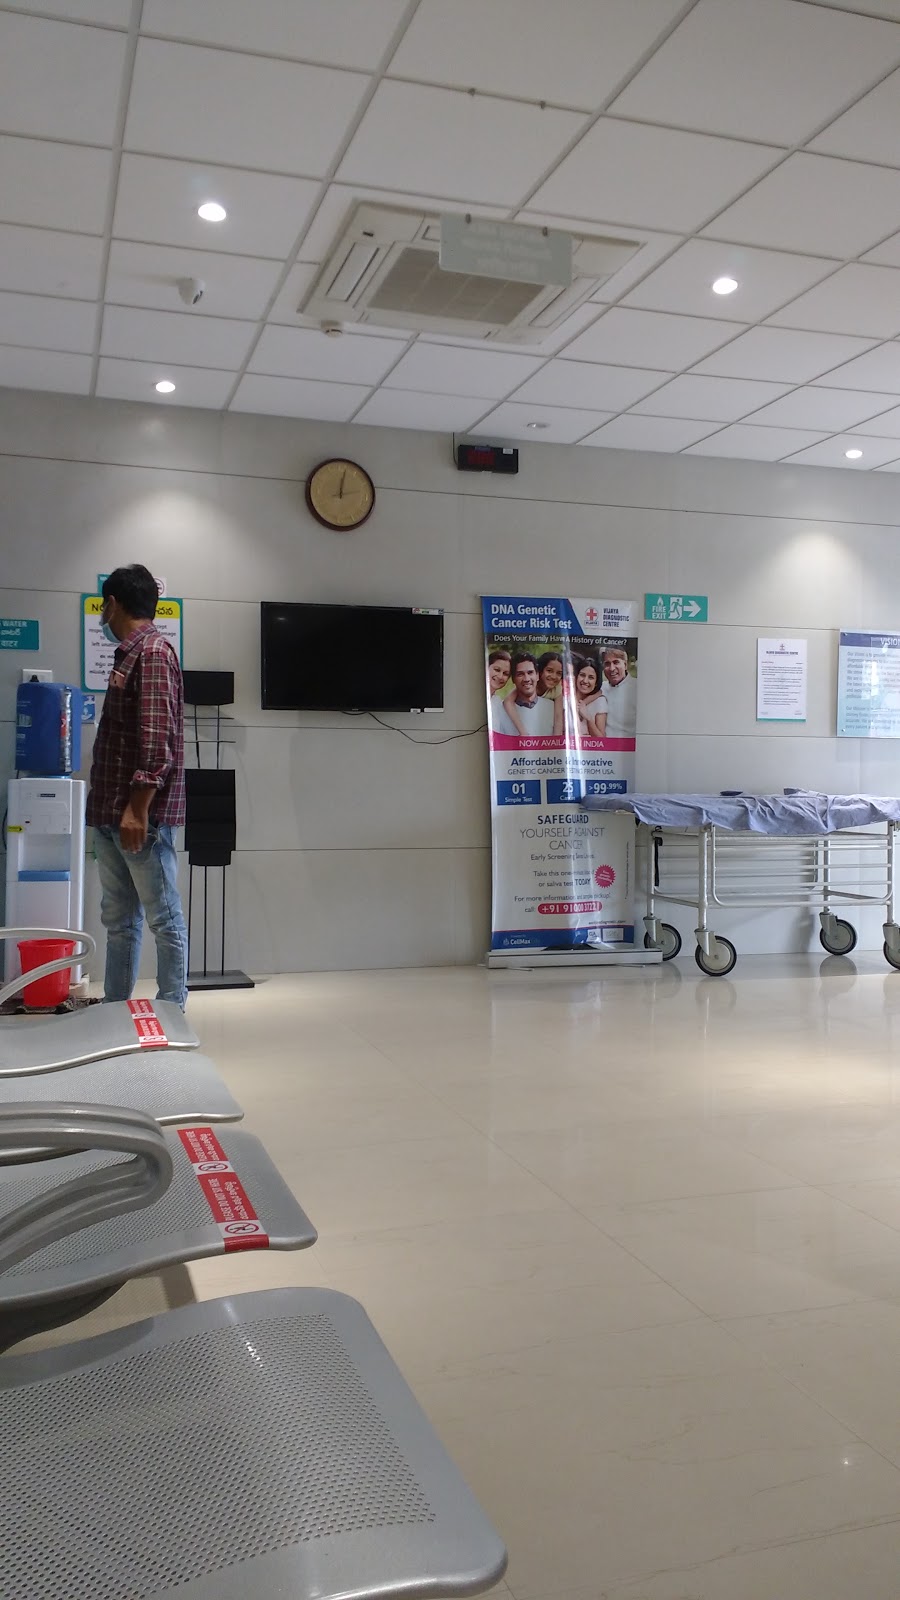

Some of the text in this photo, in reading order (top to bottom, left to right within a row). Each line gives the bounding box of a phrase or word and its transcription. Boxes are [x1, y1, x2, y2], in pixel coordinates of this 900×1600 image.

[491, 604, 556, 615] DNA Genetic
[652, 605, 666, 613] FIRE
[603, 614, 630, 622] DIAGNOSTIC
[652, 612, 666, 620] EXIT
[2, 620, 28, 628] WATER
[491, 617, 572, 630] Cancer Risk Test
[603, 620, 620, 628] CENTRE
[529, 635, 549, 644] Family
[571, 637, 594, 645] History
[511, 757, 562, 766] Affordable
[512, 783, 525, 795] 01
[538, 815, 589, 825] SAFEGUARD
[520, 828, 605, 839] YOURSELF AGAINST
[549, 840, 583, 850] CANCER
[530, 853, 546, 861] Early
[574, 878, 591, 886] TODAY
